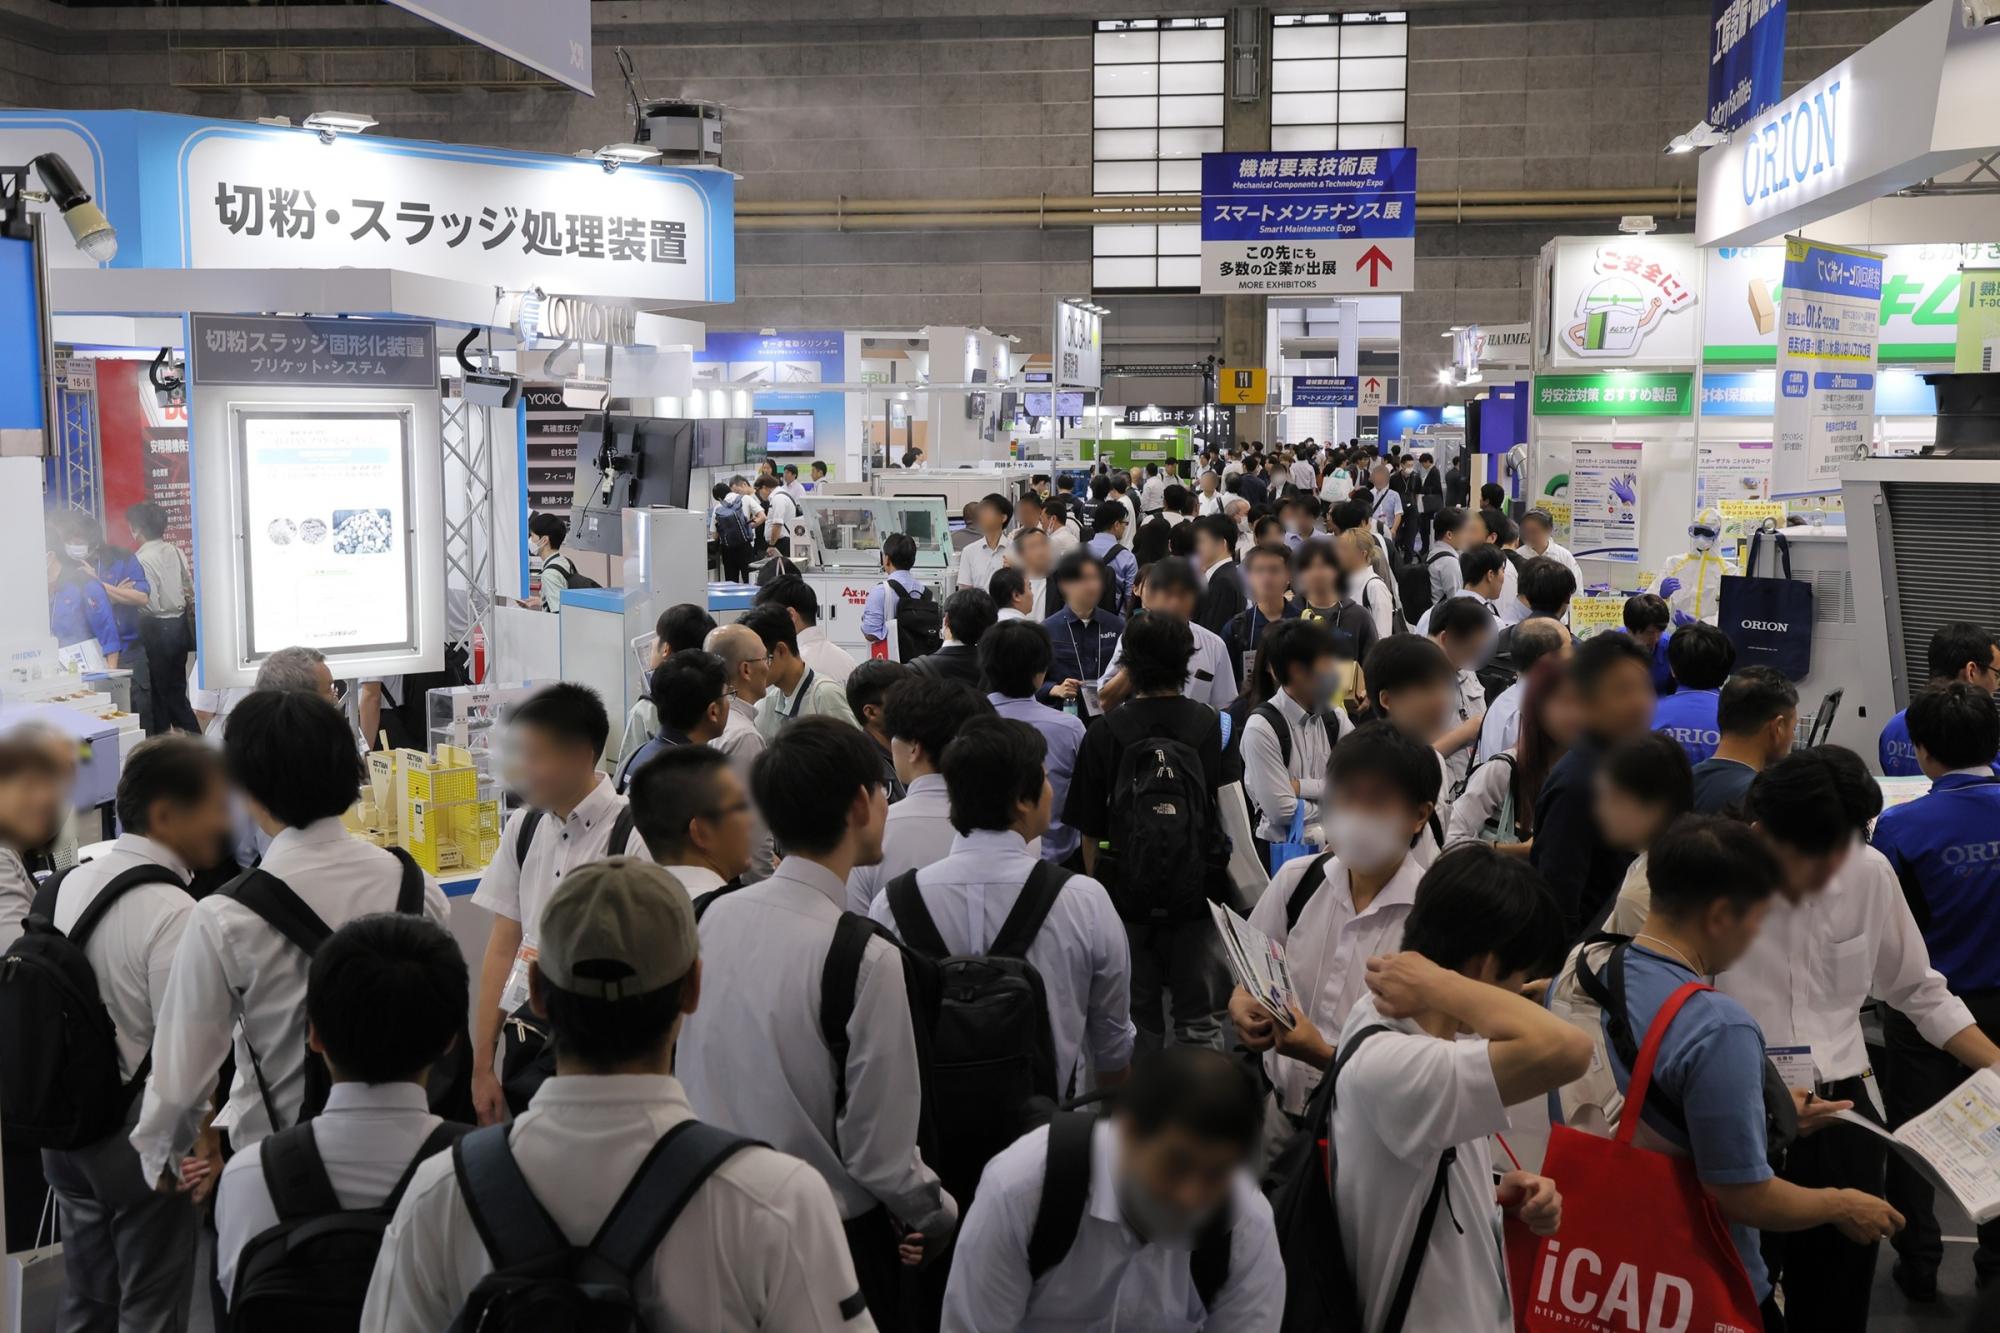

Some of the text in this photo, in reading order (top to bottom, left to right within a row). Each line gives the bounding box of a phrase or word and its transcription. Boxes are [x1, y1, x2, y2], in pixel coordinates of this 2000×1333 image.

[1743, 80, 1840, 206] ORION
[1239, 156, 1378, 178] 機械要素技術展
[1232, 181, 1272, 189] Mechanical
[1273, 180, 1317, 189] Components
[1325, 179, 1365, 188] Technology
[1366, 178, 1384, 188] Expo
[1213, 202, 1402, 222] スマートメンテナンス展
[215, 181, 686, 265] 切粉・スラッジ処理装置
[1259, 224, 1356, 233] Smart Maintenance Expo
[1246, 245, 1316, 260] この先にも
[1219, 261, 1336, 276] 多数の企業が出展
[1238, 280, 1317, 289] MORE EXHIBITORS
[205, 329, 425, 358] 切粉スラッジ固形化装置
[1541, 387, 1678, 403] 労安法対策 おすすめ製品
[541, 496, 573, 505] 絶縁オシ
[1741, 619, 1789, 632] ORION
[1537, 1239, 1694, 1333] iCAD
